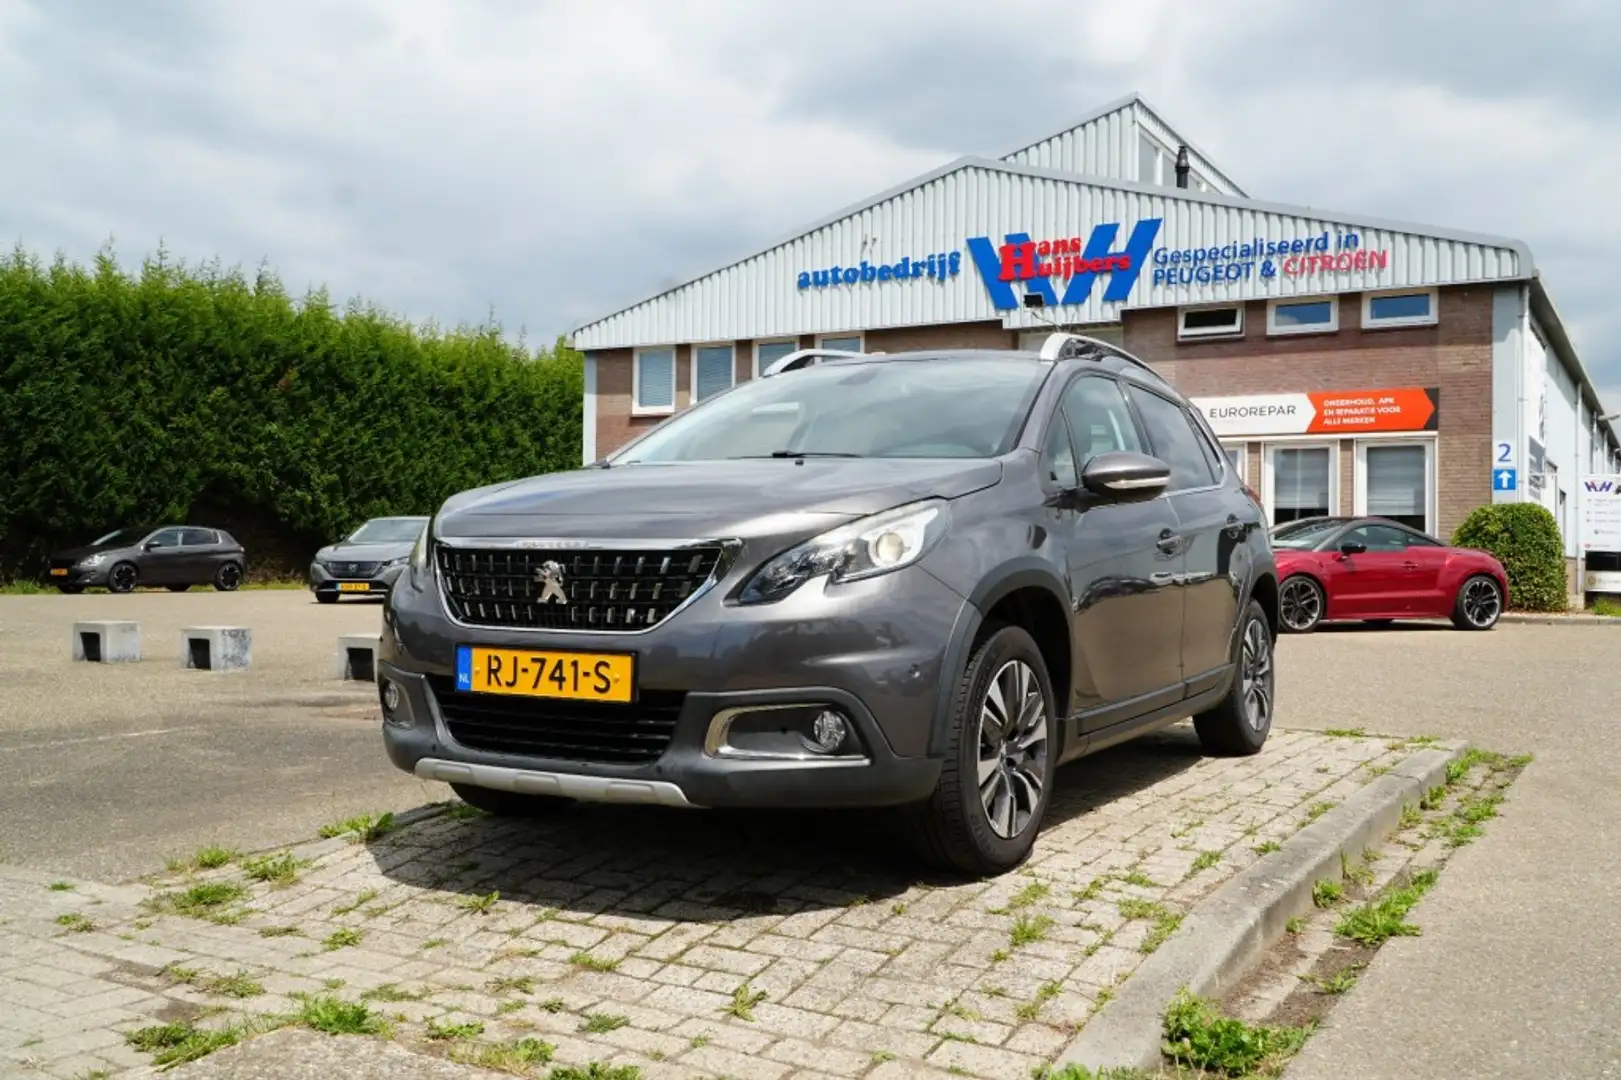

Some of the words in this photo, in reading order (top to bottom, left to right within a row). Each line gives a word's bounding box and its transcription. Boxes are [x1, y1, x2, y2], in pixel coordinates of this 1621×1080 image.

[1154, 231, 1329, 265] Gespecialiseerd
[1337, 230, 1359, 249] in
[797, 251, 961, 289] autobedrijf
[1153, 261, 1255, 286] PEUGEOT
[1260, 259, 1276, 277] &
[1209, 405, 1296, 418] EUROREPAR
[1377, 406, 1401, 415] VOOR
[1498, 443, 1512, 462] 2
[459, 673, 470, 684] NL
[487, 654, 611, 694] RJ-741-S
